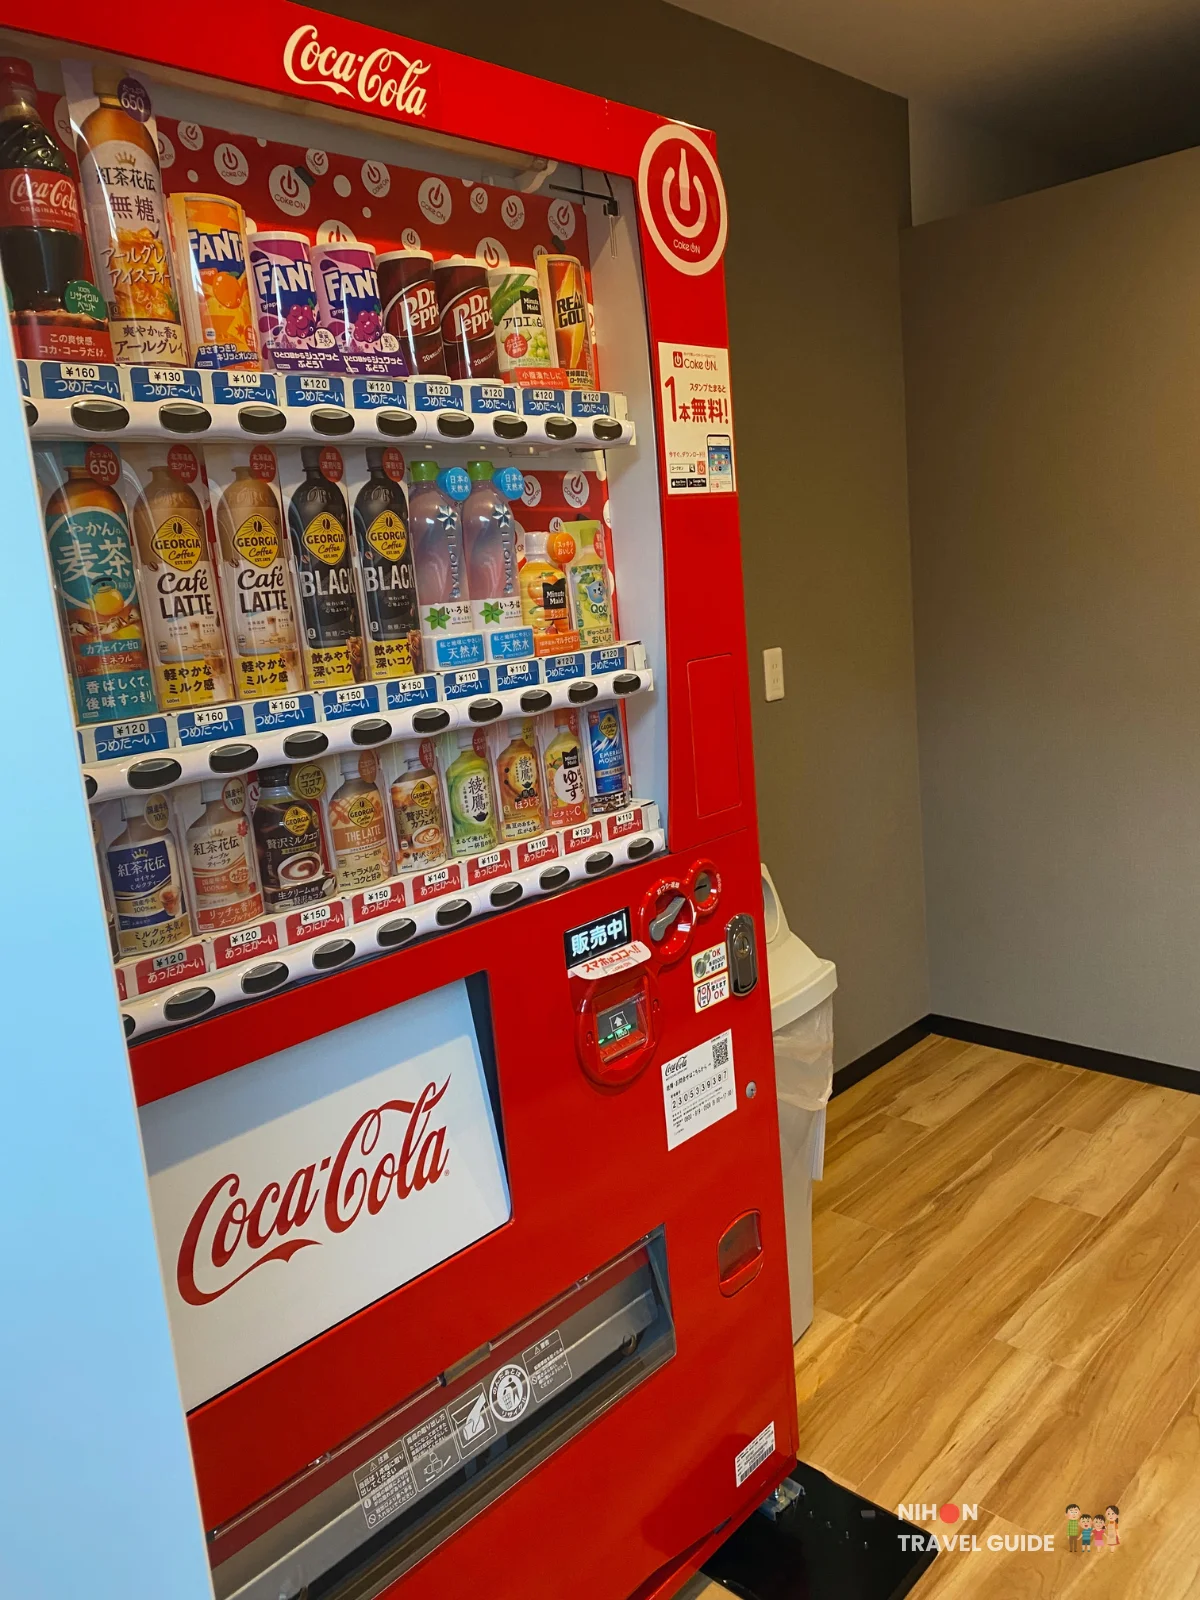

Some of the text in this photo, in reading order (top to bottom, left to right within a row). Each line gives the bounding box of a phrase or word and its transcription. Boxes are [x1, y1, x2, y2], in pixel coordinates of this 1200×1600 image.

[283, 24, 431, 116] Coca-Cola
[121, 92, 145, 113] 650
[96, 167, 157, 192] 紅茶花伝
[109, 193, 154, 223] 無糖
[673, 239, 690, 251] Coke
[108, 268, 172, 289] アイスティー
[70, 291, 99, 304] リサイクル
[417, 288, 436, 306] Dr
[469, 294, 489, 312] Dr
[77, 301, 96, 312] ペット
[123, 325, 178, 341] 爽やかに香る
[50, 334, 96, 346] この爽快感。
[39, 345, 107, 358] コカ・コーラだけ。
[199, 344, 237, 356] 甘さすっきり
[273, 351, 340, 363] ひと口目からジュワッと
[684, 358, 717, 371] Coke ON
[65, 366, 95, 378] ¥160
[154, 371, 181, 382] ¥130
[522, 371, 562, 380] 小腹満たしに
[233, 374, 257, 383] ¥100
[303, 379, 328, 389] ¥120
[368, 383, 391, 393] ¥120
[428, 385, 449, 395] ¥120
[483, 388, 503, 397] ¥120
[690, 383, 726, 393] スタンプたまると
[535, 391, 553, 400] ¥120
[582, 393, 600, 401] ¥120
[664, 376, 729, 424] 1本無料!
[90, 459, 117, 475] 650
[171, 462, 197, 471] 生クリーム
[253, 462, 275, 471] 生クリーム
[450, 475, 468, 485] 日本の
[505, 474, 523, 483] 日本の
[451, 484, 470, 493] 天然水
[505, 483, 523, 492] 天然水
[237, 536, 279, 548] GEORGIA
[306, 534, 345, 545] GEORGIA
[370, 532, 406, 542] GEORGIA
[155, 537, 201, 550] GEORGIA
[381, 541, 402, 551] Coffee
[557, 541, 573, 549] スッキリ
[168, 550, 195, 560] Coffee
[248, 546, 273, 557] Coffee
[318, 545, 341, 555] Coffee
[557, 547, 574, 556] おいしく
[57, 537, 131, 583] 麦茶
[157, 569, 209, 595] Café
[237, 566, 285, 590] Café
[546, 590, 565, 598] Minute
[159, 593, 214, 619] LATTE
[239, 589, 289, 613] LATTE
[86, 640, 139, 655] カフェインゼロ
[447, 645, 480, 660] 天然水
[501, 640, 530, 653] 天然水
[102, 655, 133, 665] ミネラル
[602, 650, 618, 658] ¥120
[241, 657, 286, 673] 軽やかな
[375, 656, 412, 669] 深いコク
[557, 656, 574, 666] ¥120
[164, 664, 213, 681] 軽やかな
[313, 664, 352, 678] 深いコク
[510, 664, 527, 674] ¥110
[246, 671, 289, 686] ミルク感
[458, 672, 477, 682] ¥110
[86, 675, 149, 695] 香ばしくて、
[168, 677, 216, 695] ミルク感
[401, 681, 422, 690] ¥150
[86, 690, 152, 711] 後味すっきり
[339, 690, 362, 701] ¥150
[271, 700, 296, 710] ¥160
[196, 711, 223, 722] ¥160
[116, 723, 146, 735] ¥120
[518, 755, 531, 783] 綾鷹
[301, 776, 322, 788] ココア
[563, 770, 578, 801] ゆず
[412, 791, 432, 800] GEORGIA
[468, 775, 486, 813] 綾鷹
[514, 797, 540, 811] ほうじ茶
[350, 807, 375, 819] GEORGIA
[553, 806, 581, 818] ビタミンC
[285, 814, 310, 827] GEORGIA
[617, 815, 632, 823] ¥110
[345, 824, 382, 843] THE LATTE
[575, 827, 591, 837] ¥130
[192, 835, 240, 857] 紅茶花伝
[530, 840, 547, 850] ¥110
[208, 852, 230, 862] メープル
[481, 855, 499, 865] ¥110
[117, 855, 166, 878] 紅茶花伝
[342, 864, 381, 878] キャラメルの
[134, 874, 156, 883] ロイヤル
[353, 872, 382, 885] コクと甘み
[427, 871, 446, 883] ¥140
[130, 879, 161, 891] ミルクティー
[293, 891, 323, 907] 贅沢なコク
[368, 891, 389, 901] ¥150
[209, 900, 257, 920] リッチな香りの
[303, 910, 326, 921] ¥150
[219, 906, 262, 927] メープルティーラテ
[142, 930, 182, 949] ミルクティー
[231, 930, 257, 944] ¥120
[571, 918, 623, 957] 販売中
[711, 947, 721, 958] OK
[156, 952, 184, 967] ¥120
[581, 944, 641, 974] スマホはココへ!!
[714, 988, 725, 1000] OK
[177, 1073, 451, 1306] Coca-Cola
[493, 1368, 521, 1395] のんだあとは
[502, 1395, 526, 1418] リサイクル
